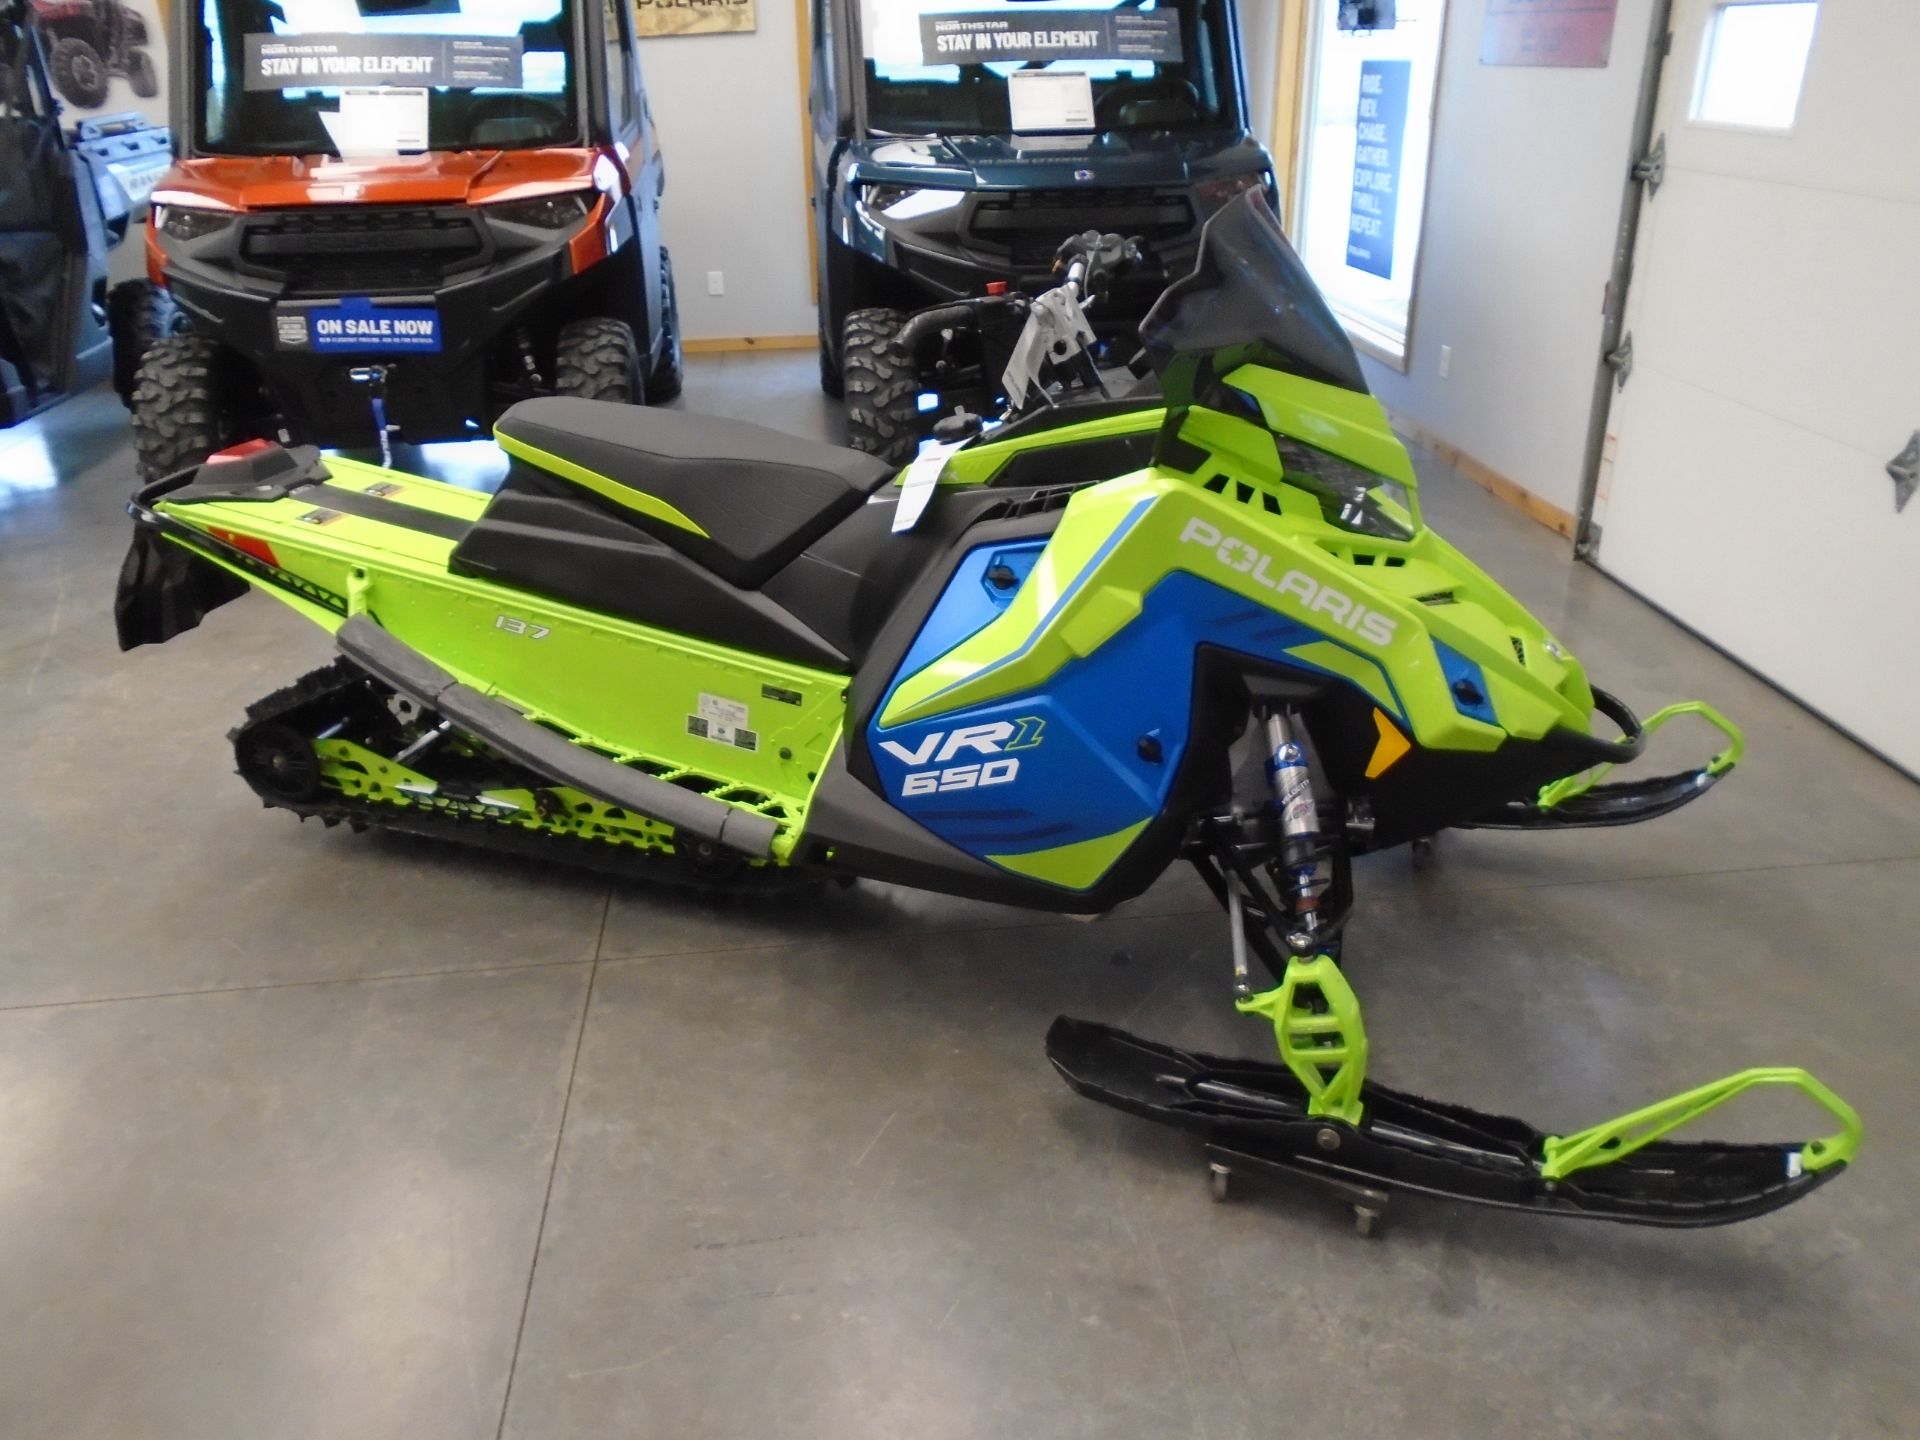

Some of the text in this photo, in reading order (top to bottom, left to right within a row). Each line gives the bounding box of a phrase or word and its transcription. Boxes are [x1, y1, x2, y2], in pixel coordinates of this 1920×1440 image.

[936, 32, 973, 52] STAY
[975, 33, 992, 49] IN
[993, 31, 1033, 49] YOUR
[1034, 30, 1099, 47] ELEMENT
[261, 57, 300, 76] STAY
[301, 58, 319, 74] IN
[320, 56, 362, 74] YOUR
[363, 56, 434, 73] ELEMENT
[317, 319, 342, 335] ON
[345, 319, 392, 335] SALE
[394, 320, 433, 336] NOW
[1179, 516, 1398, 646] POLARIS
[496, 615, 550, 639] 137
[878, 716, 1046, 766] VR1
[902, 758, 1020, 797] 650
